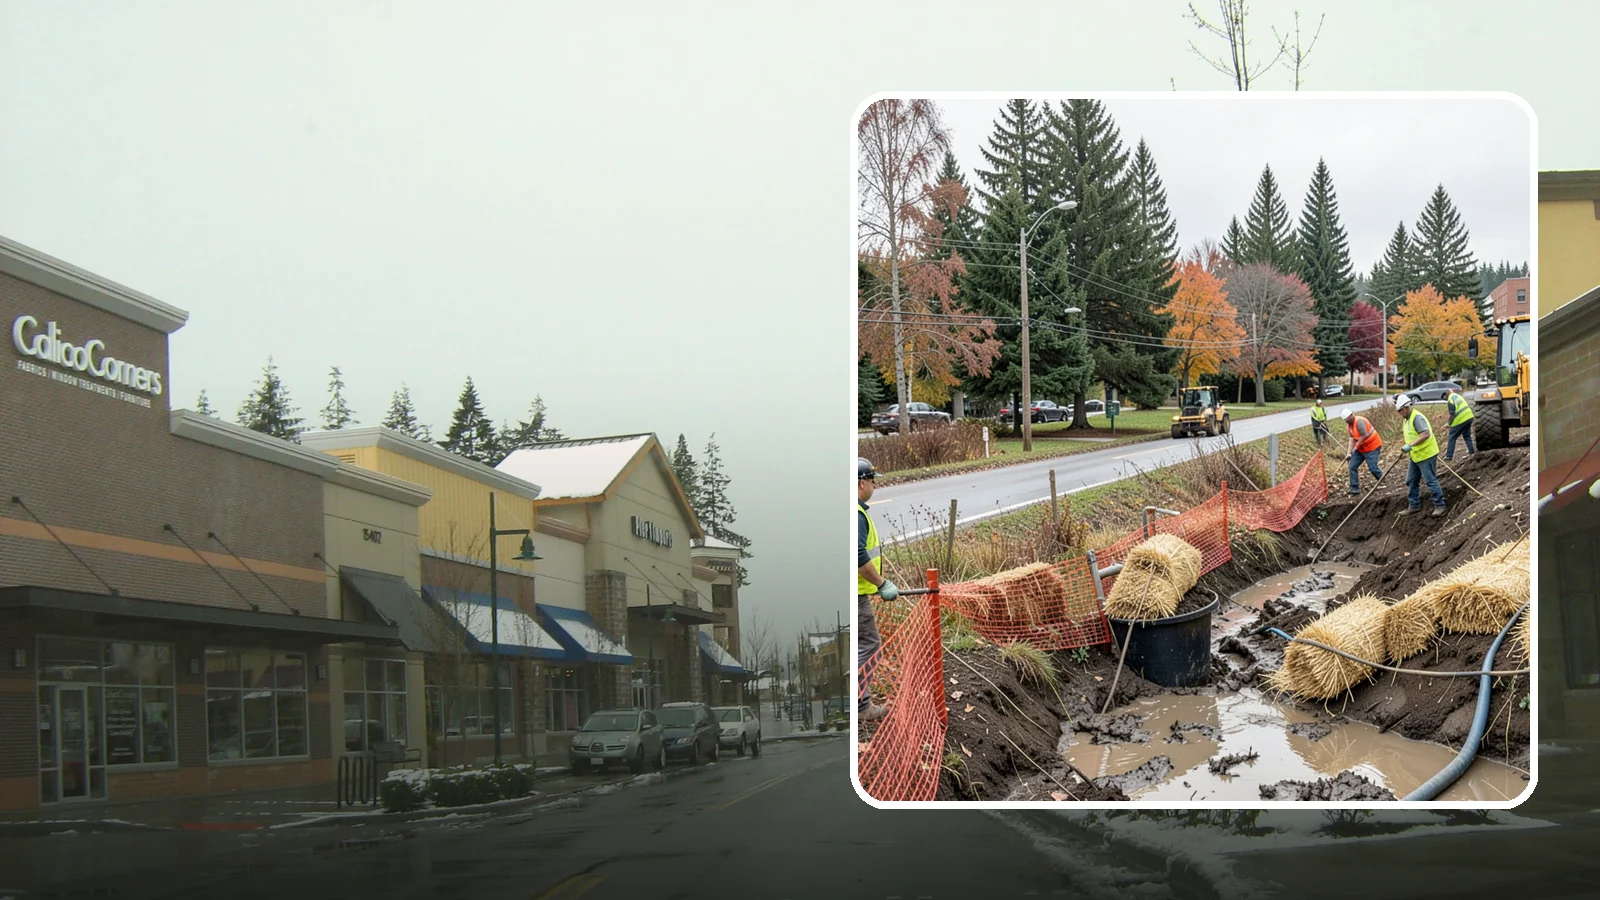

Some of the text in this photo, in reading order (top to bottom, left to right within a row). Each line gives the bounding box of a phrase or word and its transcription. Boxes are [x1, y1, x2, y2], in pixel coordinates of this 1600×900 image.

[17, 360, 151, 409] FABRICS WINDOW TREATMENTS FURNITURE
